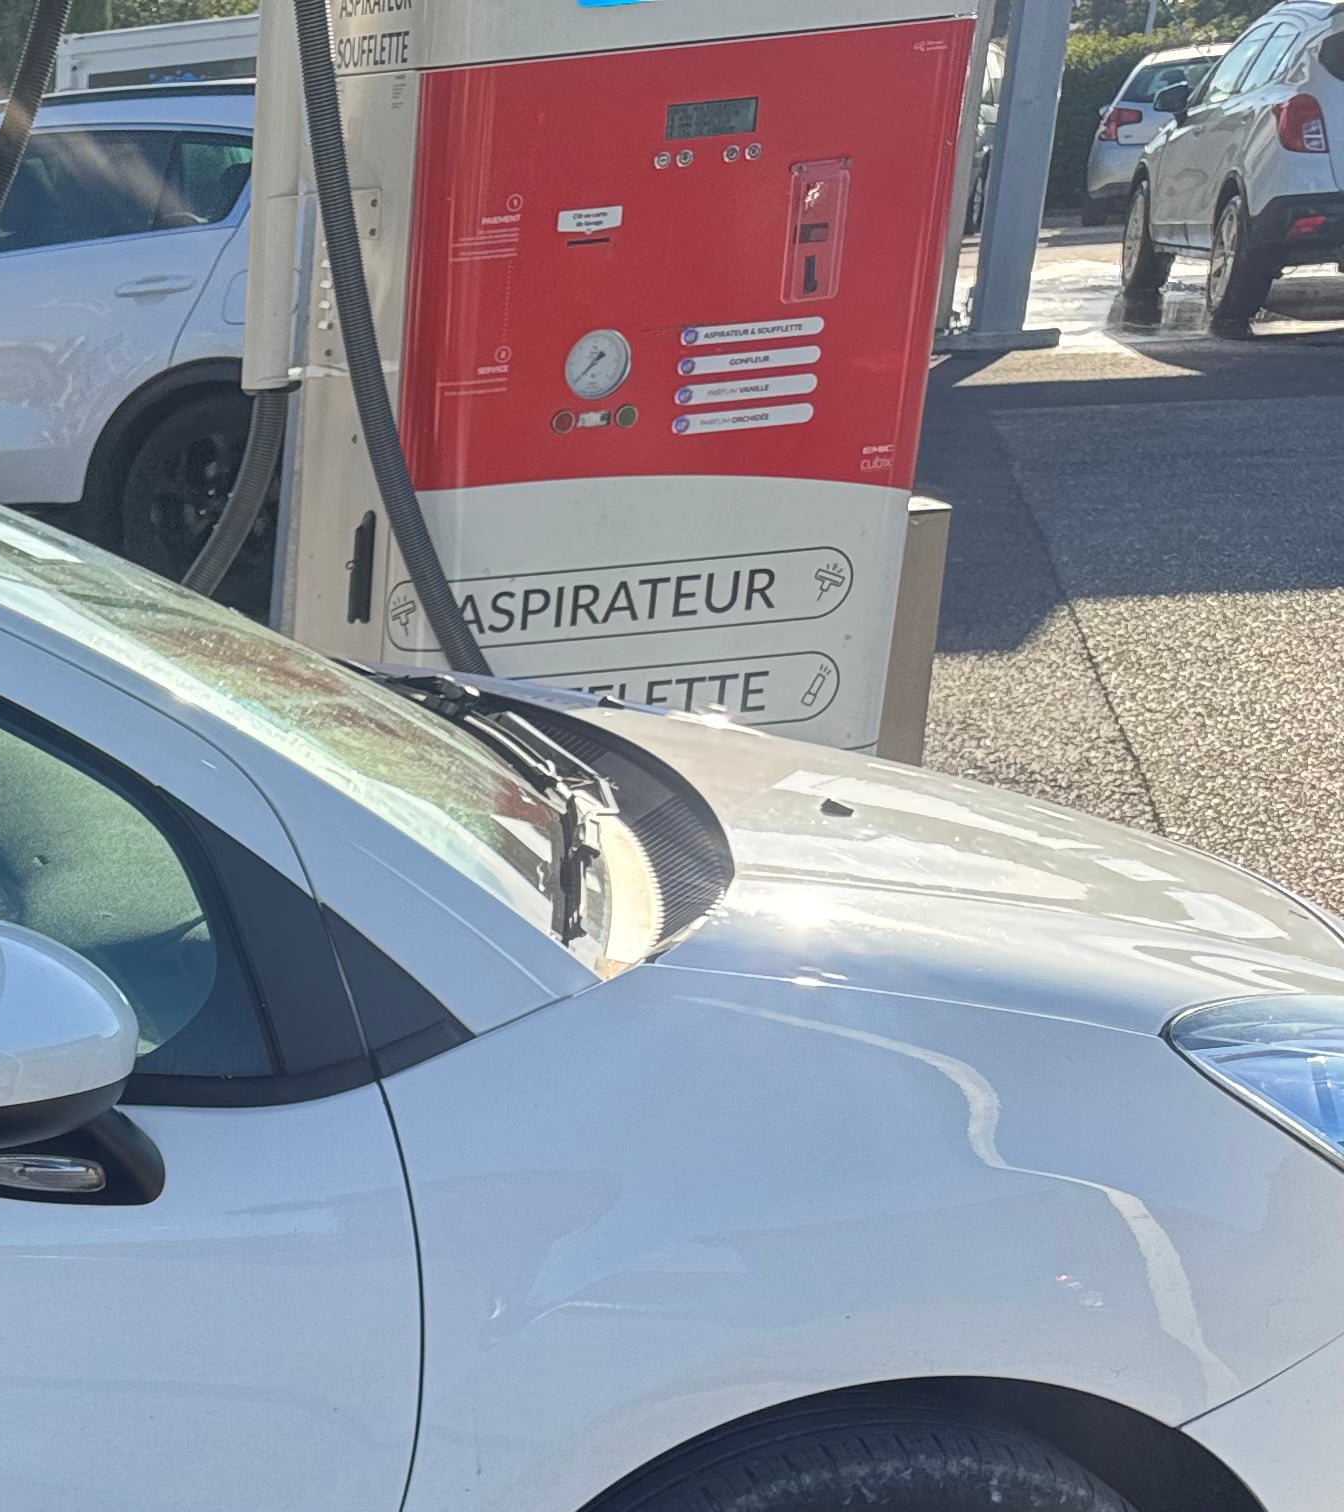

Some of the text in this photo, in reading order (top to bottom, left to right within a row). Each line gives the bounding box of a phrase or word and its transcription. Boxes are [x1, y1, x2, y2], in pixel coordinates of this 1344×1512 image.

[337, 31, 410, 69] SOUFFLETTE
[703, 329, 749, 339] ASPIRATEUR
[757, 323, 803, 335] SOUFFLETTE
[729, 355, 770, 366] GONFLEUR
[739, 384, 770, 393] VANILLE
[460, 568, 776, 635] ASPIRATEUR
